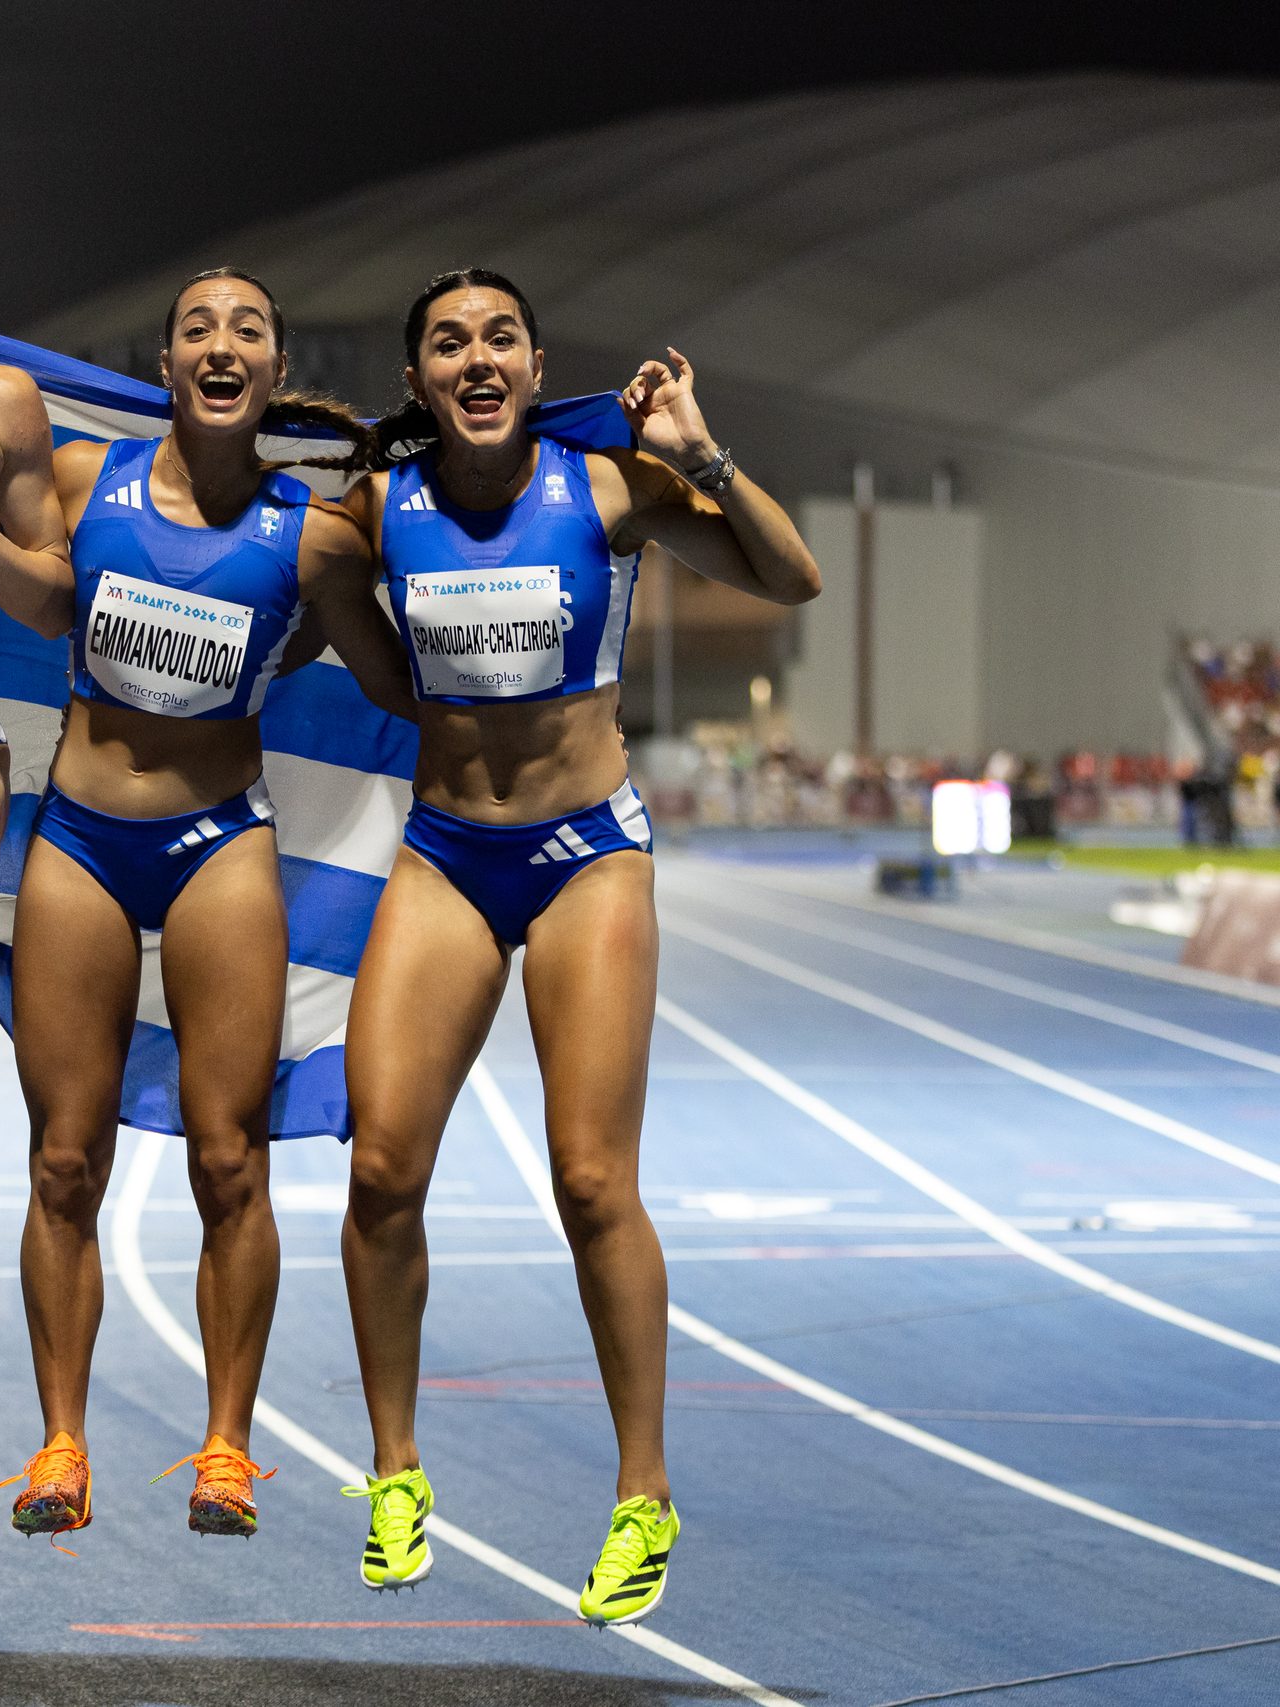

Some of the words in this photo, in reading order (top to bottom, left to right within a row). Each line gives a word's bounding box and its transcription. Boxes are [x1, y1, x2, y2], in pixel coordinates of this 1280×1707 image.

[432, 582, 487, 595] TARANTO
[489, 580, 523, 592] 2026
[127, 590, 181, 613] TARANTO
[183, 605, 217, 623] 2026
[90, 611, 243, 690] EMMANOUILIDOU
[414, 620, 560, 656] SPANOUDAKI-CHATZIRIGA
